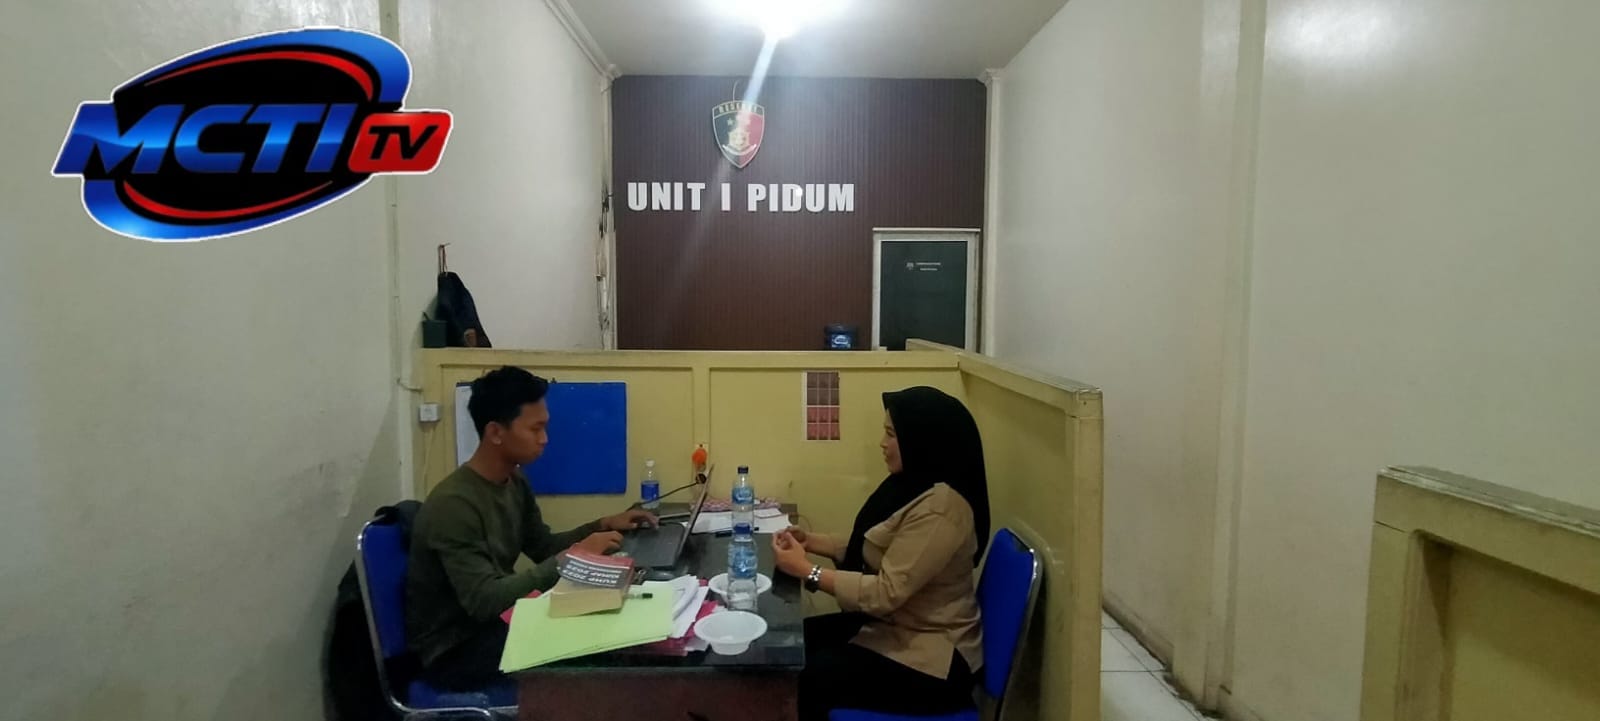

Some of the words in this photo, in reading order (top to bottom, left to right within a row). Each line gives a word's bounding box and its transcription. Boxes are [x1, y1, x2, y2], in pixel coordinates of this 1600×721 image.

[627, 182, 706, 212] UNIT
[720, 182, 731, 212] I
[747, 183, 855, 212] PIDUM
